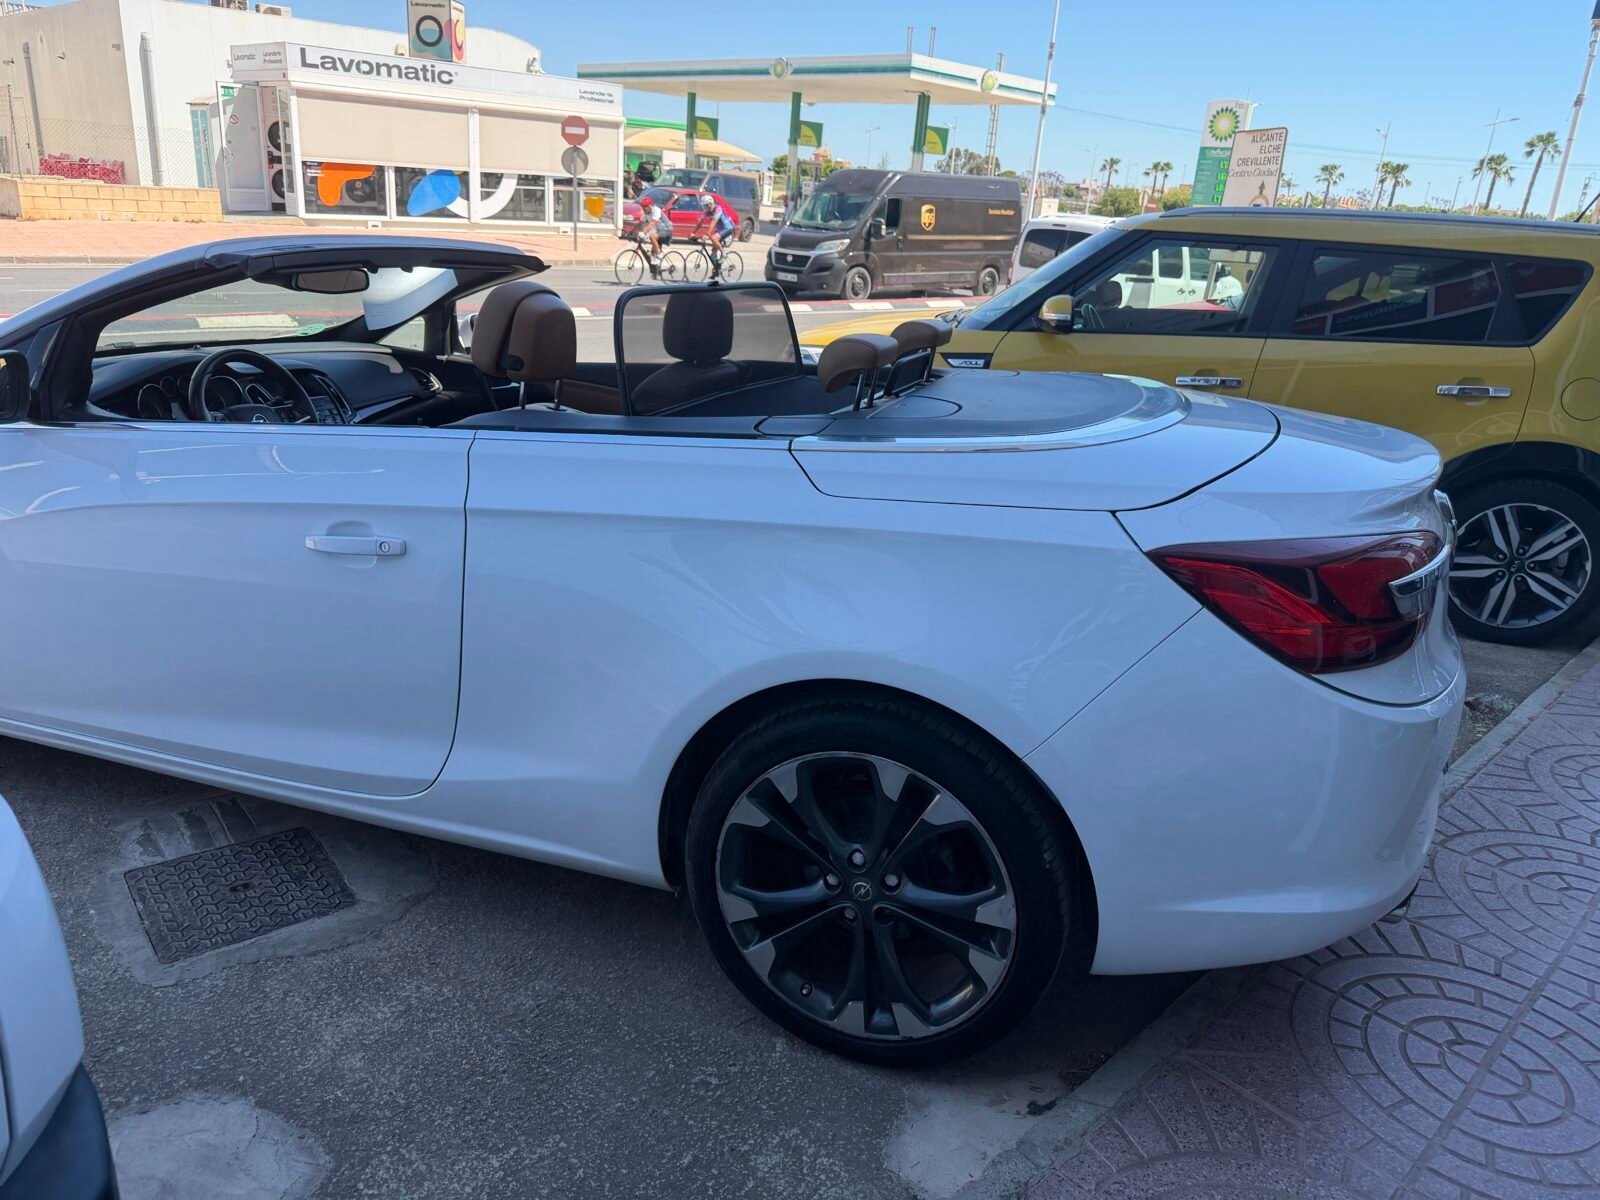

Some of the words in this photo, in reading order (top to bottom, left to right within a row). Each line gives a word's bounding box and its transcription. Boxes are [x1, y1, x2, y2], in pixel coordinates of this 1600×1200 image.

[299, 47, 454, 85] Lavomatic
[1251, 132, 1284, 144] ALICANTE
[1259, 144, 1282, 155] ELCHE
[1236, 155, 1280, 168] CREVILLENTE
[1228, 168, 1252, 178] Centro
[1252, 167, 1278, 178] Ciudad
